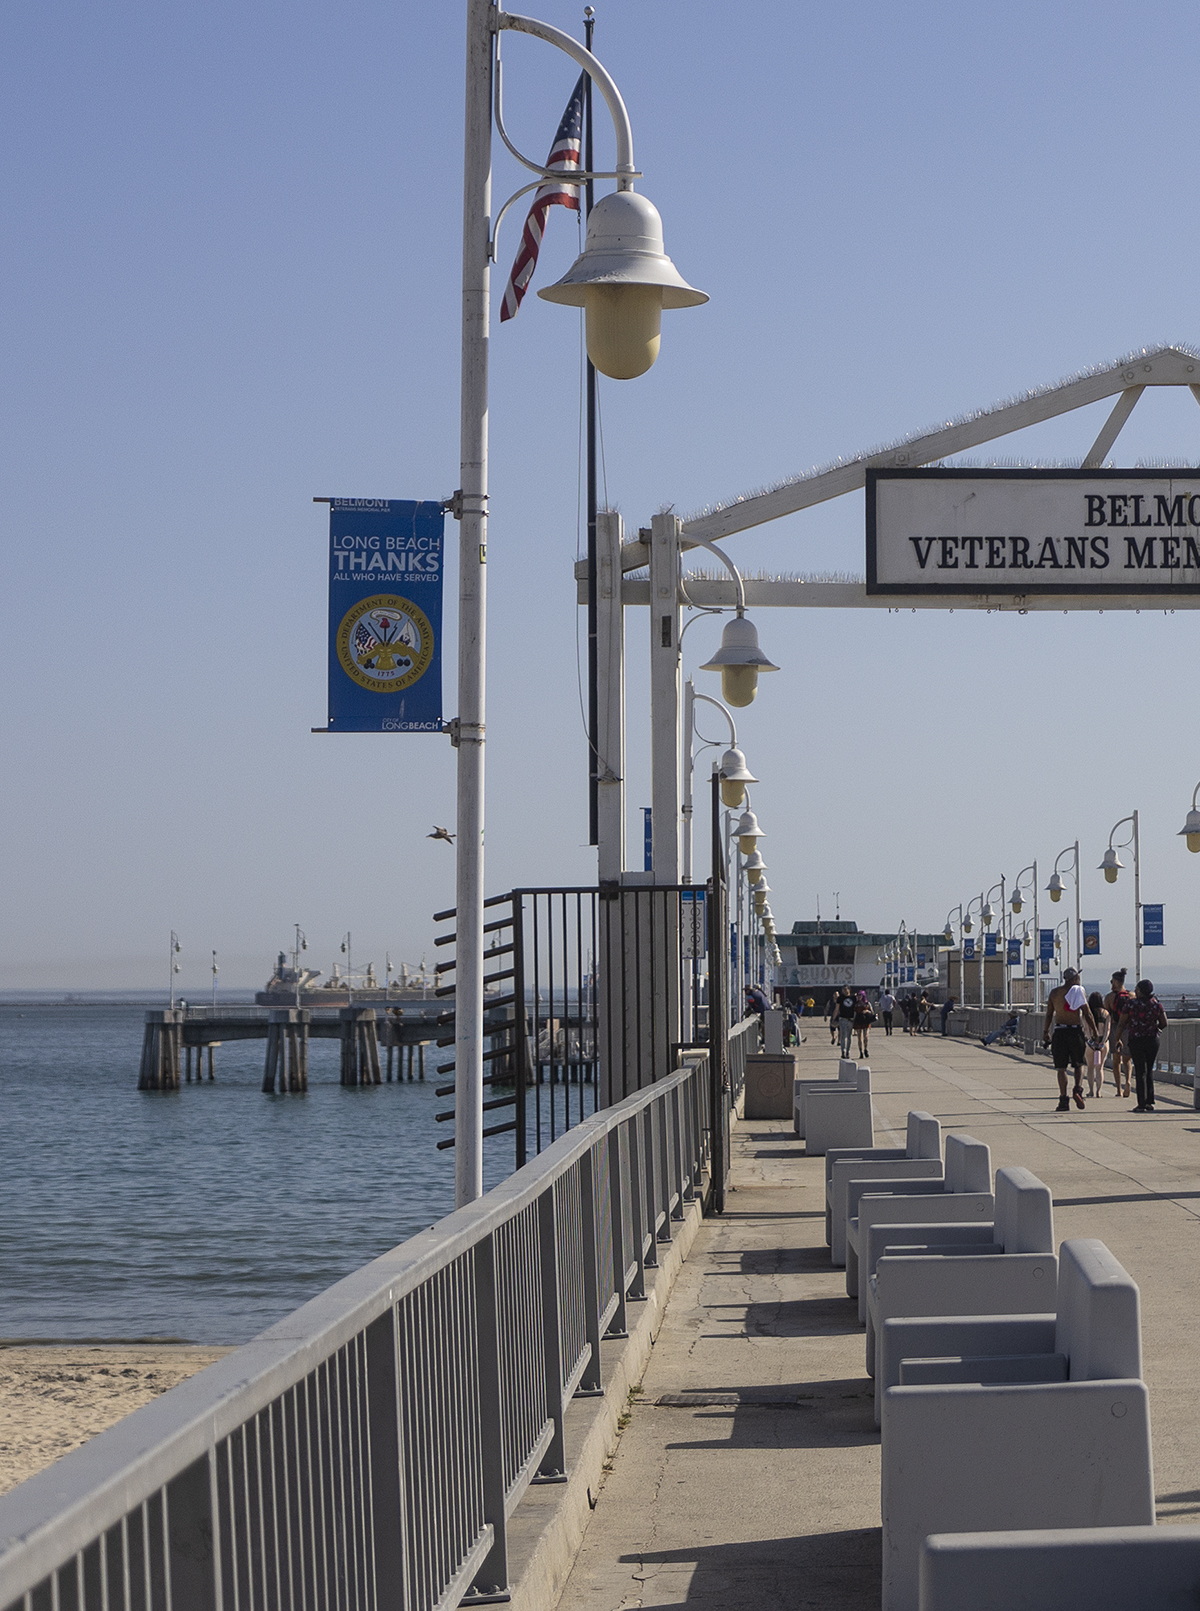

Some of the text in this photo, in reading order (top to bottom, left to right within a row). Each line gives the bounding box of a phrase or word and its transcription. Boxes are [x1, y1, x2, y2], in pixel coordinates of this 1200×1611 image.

[333, 535, 440, 551] LONG BEACH
[908, 535, 1111, 570] VETERANS
[333, 550, 440, 573] THANKS
[333, 572, 439, 582] ALL WHO HAVE SERVED
[342, 598, 383, 639] DEPARTMENT
[387, 598, 397, 607] OF
[401, 602, 417, 616] THE
[416, 617, 431, 642] ARMY
[341, 646, 430, 689] UNITED STATES OF AMERICA
[381, 721, 439, 730] LONGBEACH
[800, 966, 853, 981] BUOY'S
